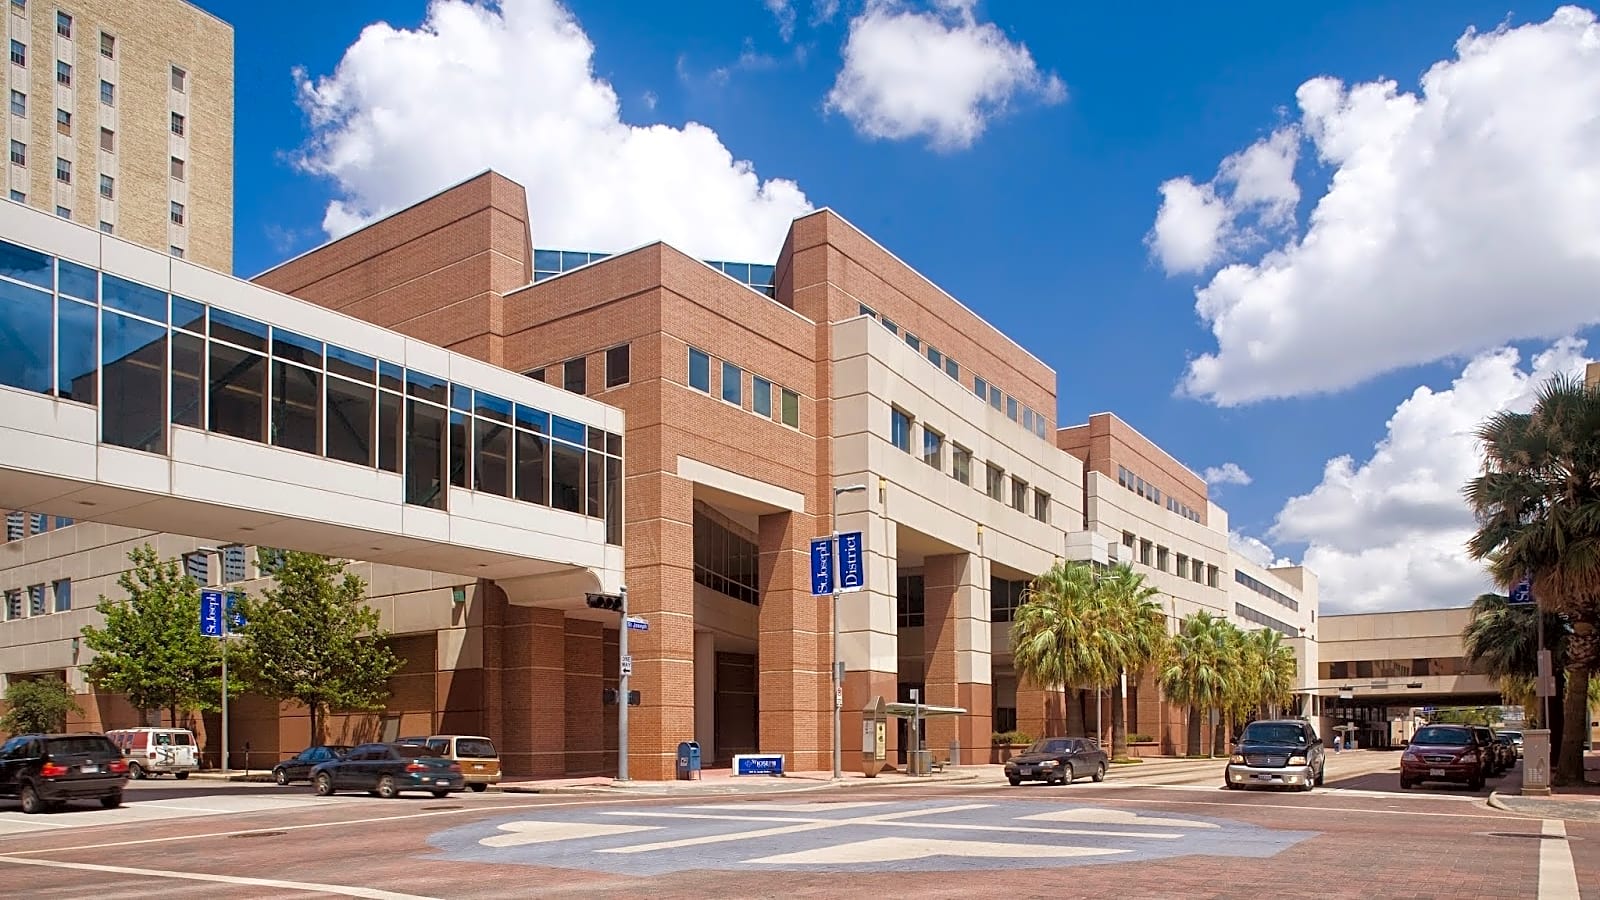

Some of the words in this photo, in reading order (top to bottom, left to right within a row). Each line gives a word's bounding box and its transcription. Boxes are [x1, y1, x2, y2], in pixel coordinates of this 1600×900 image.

[816, 542, 830, 578] Joseph
[845, 536, 858, 586] District
[206, 594, 219, 622] Joseph
[633, 622, 648, 630] Joseph
